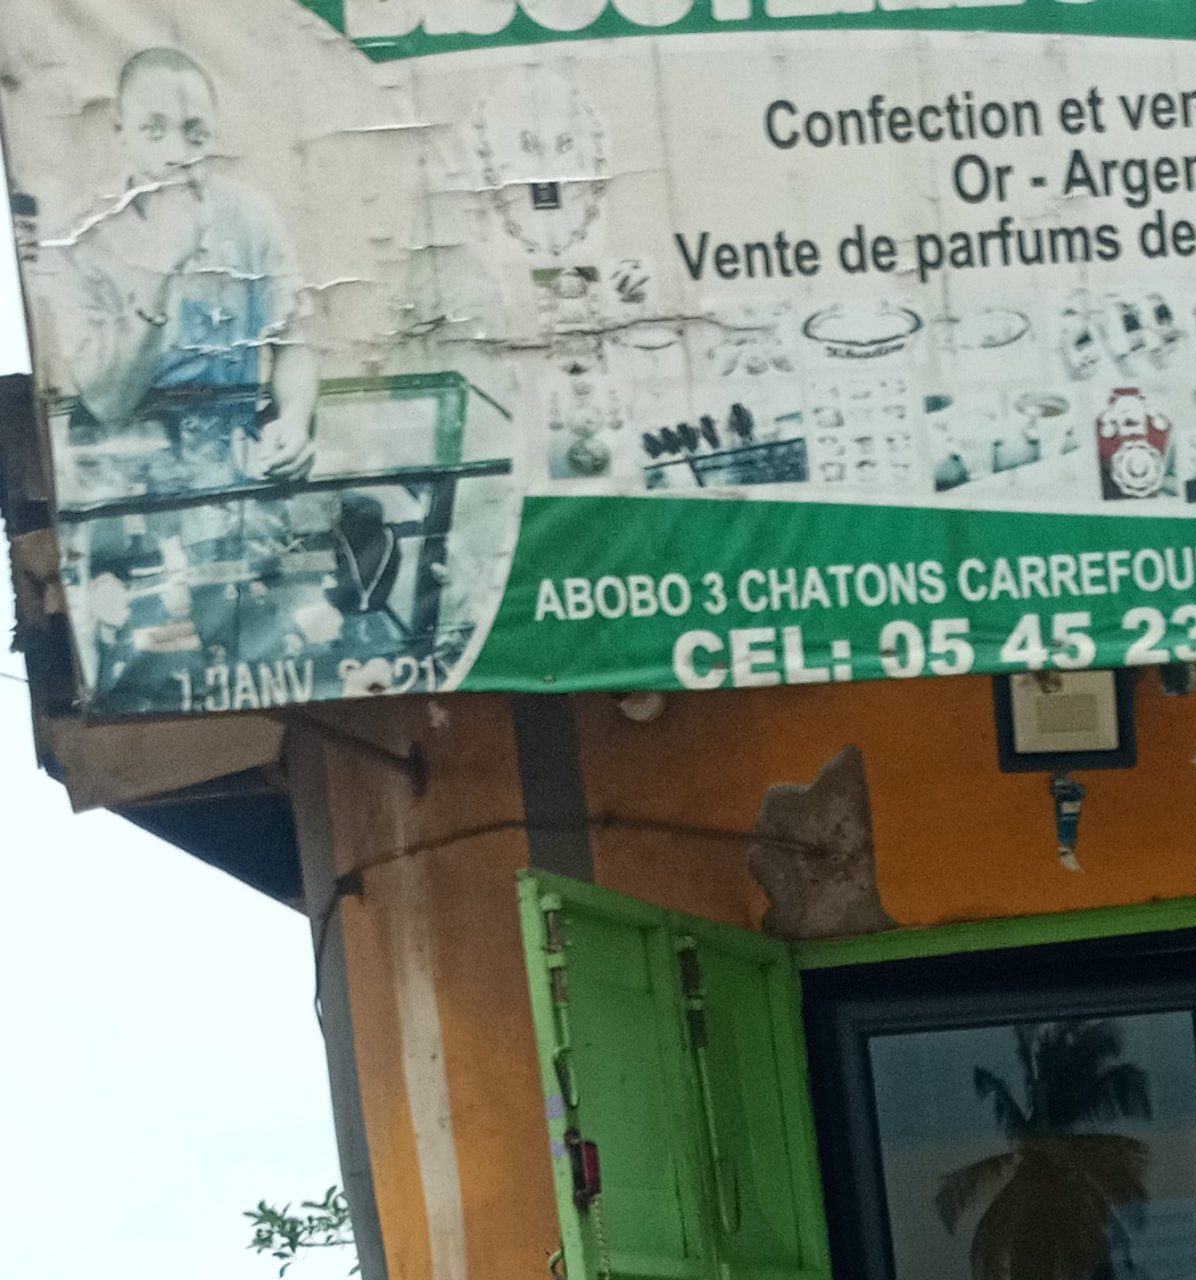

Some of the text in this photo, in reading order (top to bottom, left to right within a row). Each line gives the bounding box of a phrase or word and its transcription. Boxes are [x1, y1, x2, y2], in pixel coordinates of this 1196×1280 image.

[764, 90, 1043, 150] Confection
[1059, 86, 1106, 135] et
[953, 154, 1014, 204] Or
[674, 230, 821, 281] Vente
[839, 224, 898, 273] de
[914, 216, 1122, 283] parfums
[534, 573, 693, 622] ABOBO
[701, 571, 729, 615] 3
[738, 560, 948, 613] CHATONS
[673, 625, 852, 691] CEL:
[879, 617, 976, 679] 05
[1000, 611, 1097, 671] 45
